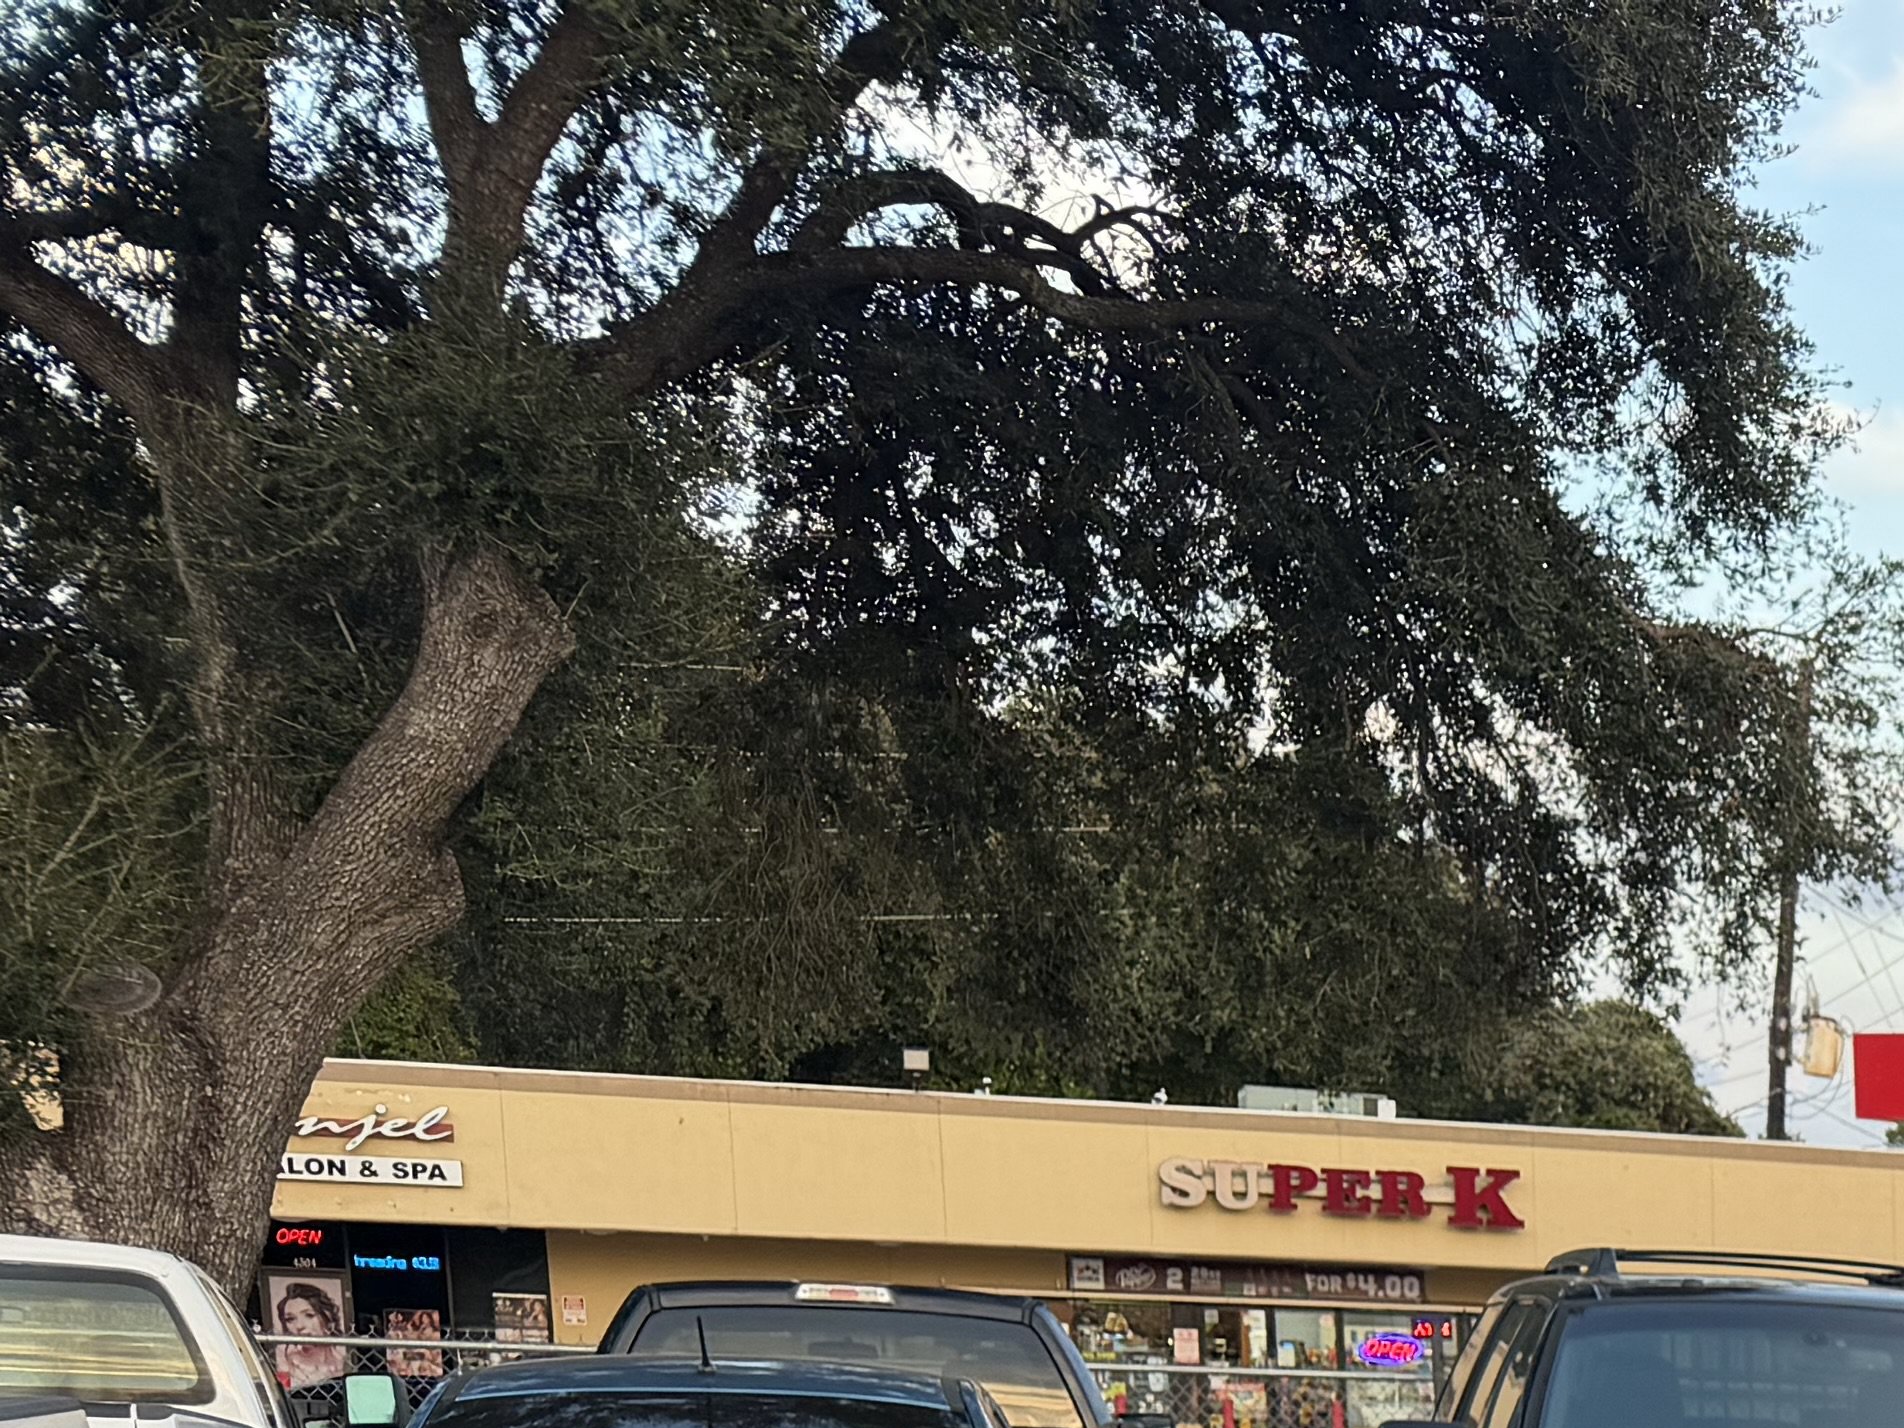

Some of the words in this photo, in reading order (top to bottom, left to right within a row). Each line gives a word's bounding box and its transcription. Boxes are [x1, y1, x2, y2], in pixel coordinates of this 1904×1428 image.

[295, 1104, 453, 1151] njel
[279, 1157, 346, 1177] LON
[359, 1160, 379, 1178] &
[392, 1162, 448, 1181] SPA
[1159, 1157, 1432, 1217] SUPER
[1446, 1165, 1525, 1231] K
[275, 1227, 323, 1247] OPEN
[1305, 1272, 1342, 1293] FOR
[1364, 1337, 1417, 1361] OPEN
